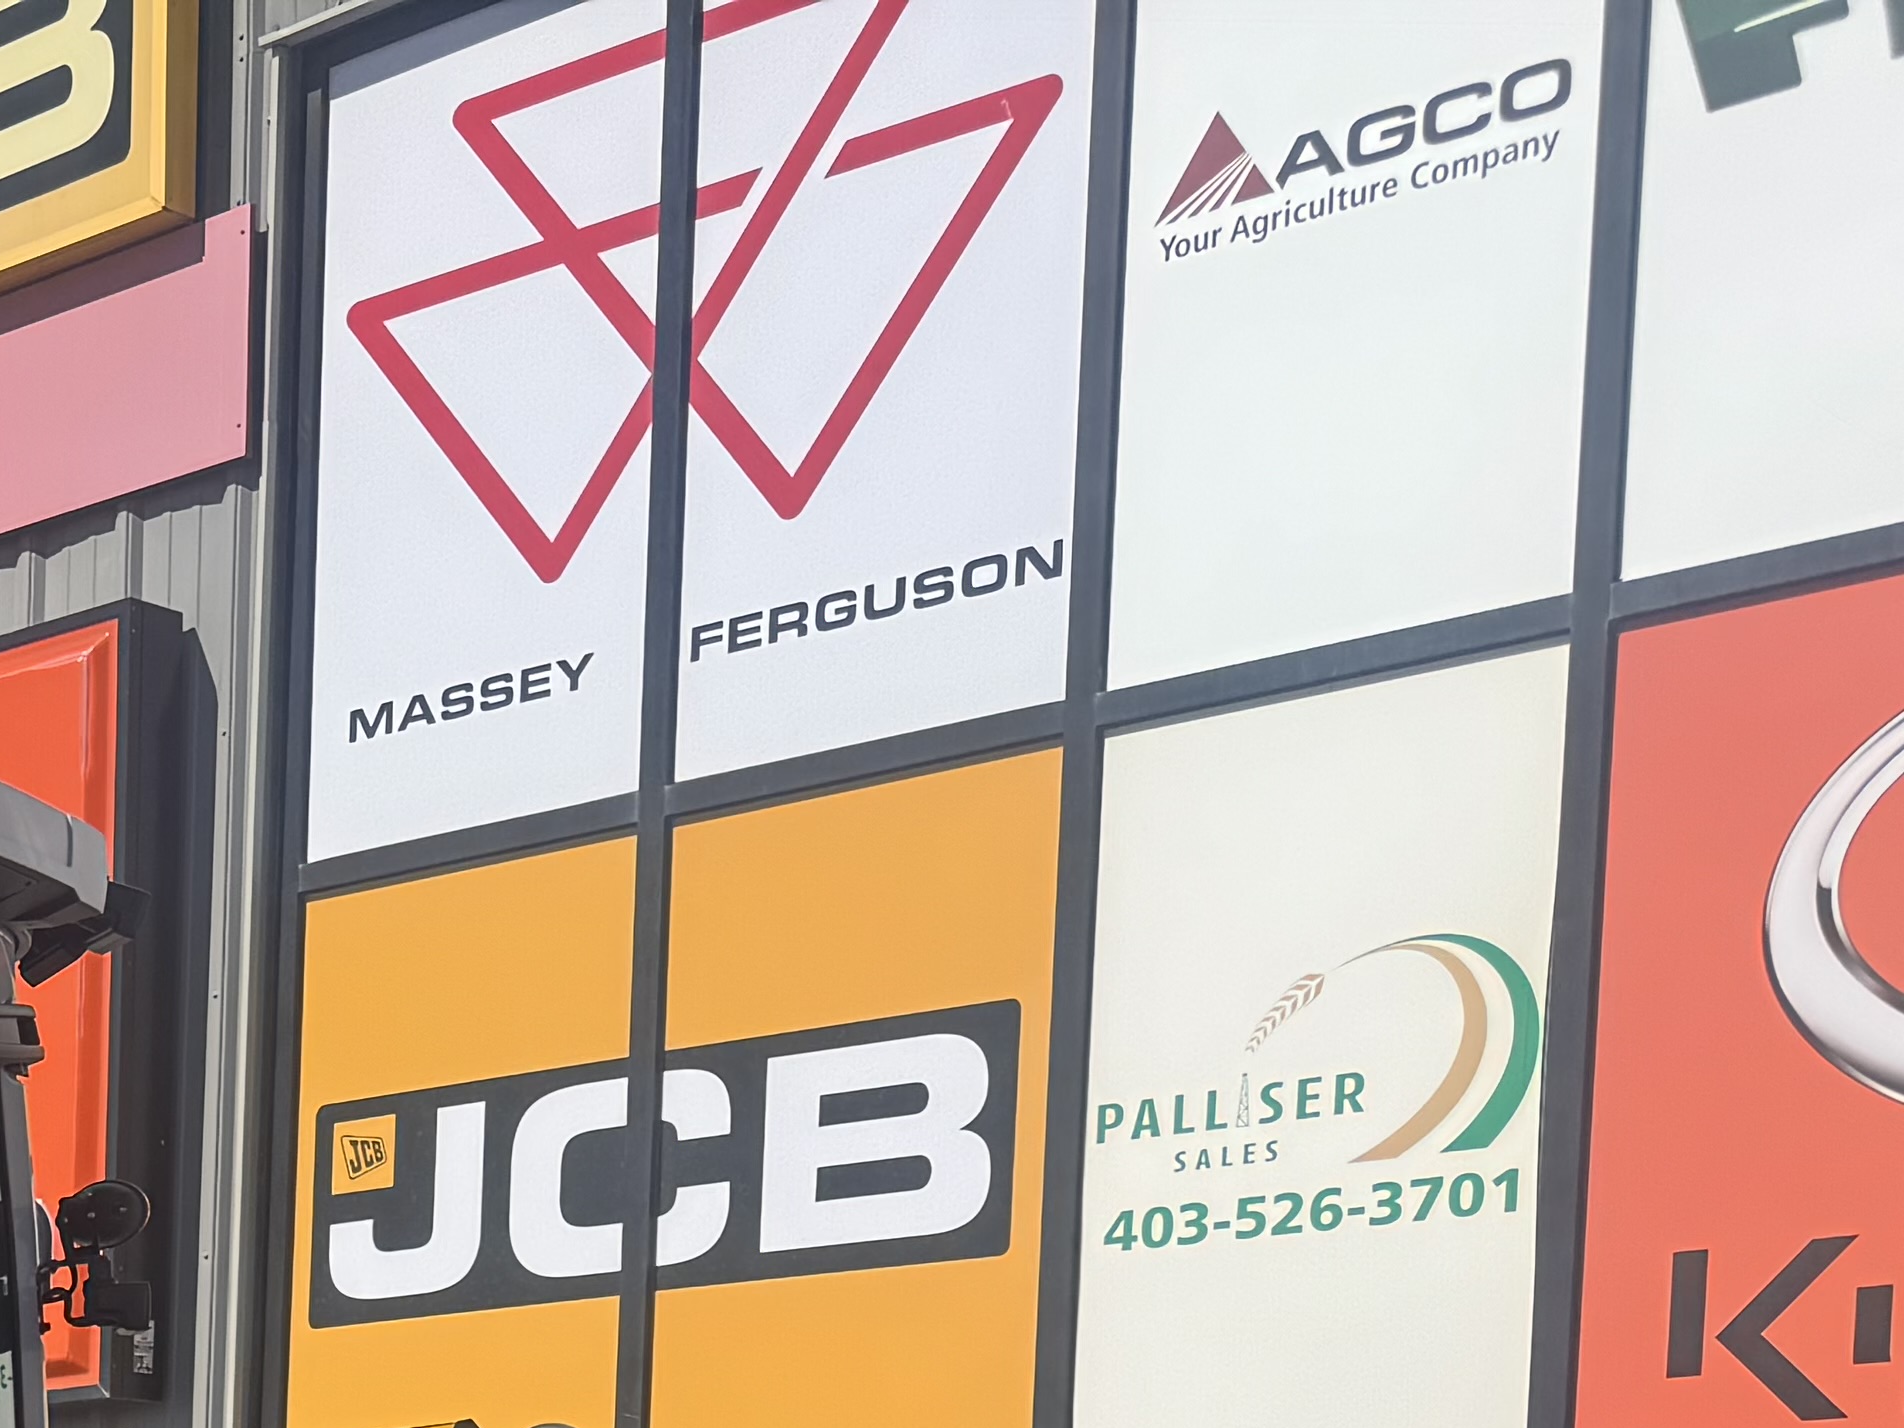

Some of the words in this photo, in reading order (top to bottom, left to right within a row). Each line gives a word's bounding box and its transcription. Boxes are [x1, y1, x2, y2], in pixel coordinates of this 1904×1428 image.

[1275, 58, 1573, 191] AGCO
[1160, 225, 1223, 263] Your
[1230, 172, 1398, 244] Agriculture
[1410, 129, 1561, 191] Company
[347, 652, 595, 744] MASSEY
[689, 539, 1065, 664] FERGUSON
[329, 1033, 993, 1301] JCB
[349, 1140, 384, 1174] JCB
[1103, 1168, 1522, 1252] 403-526-3701
[1173, 1140, 1280, 1174] SALES
